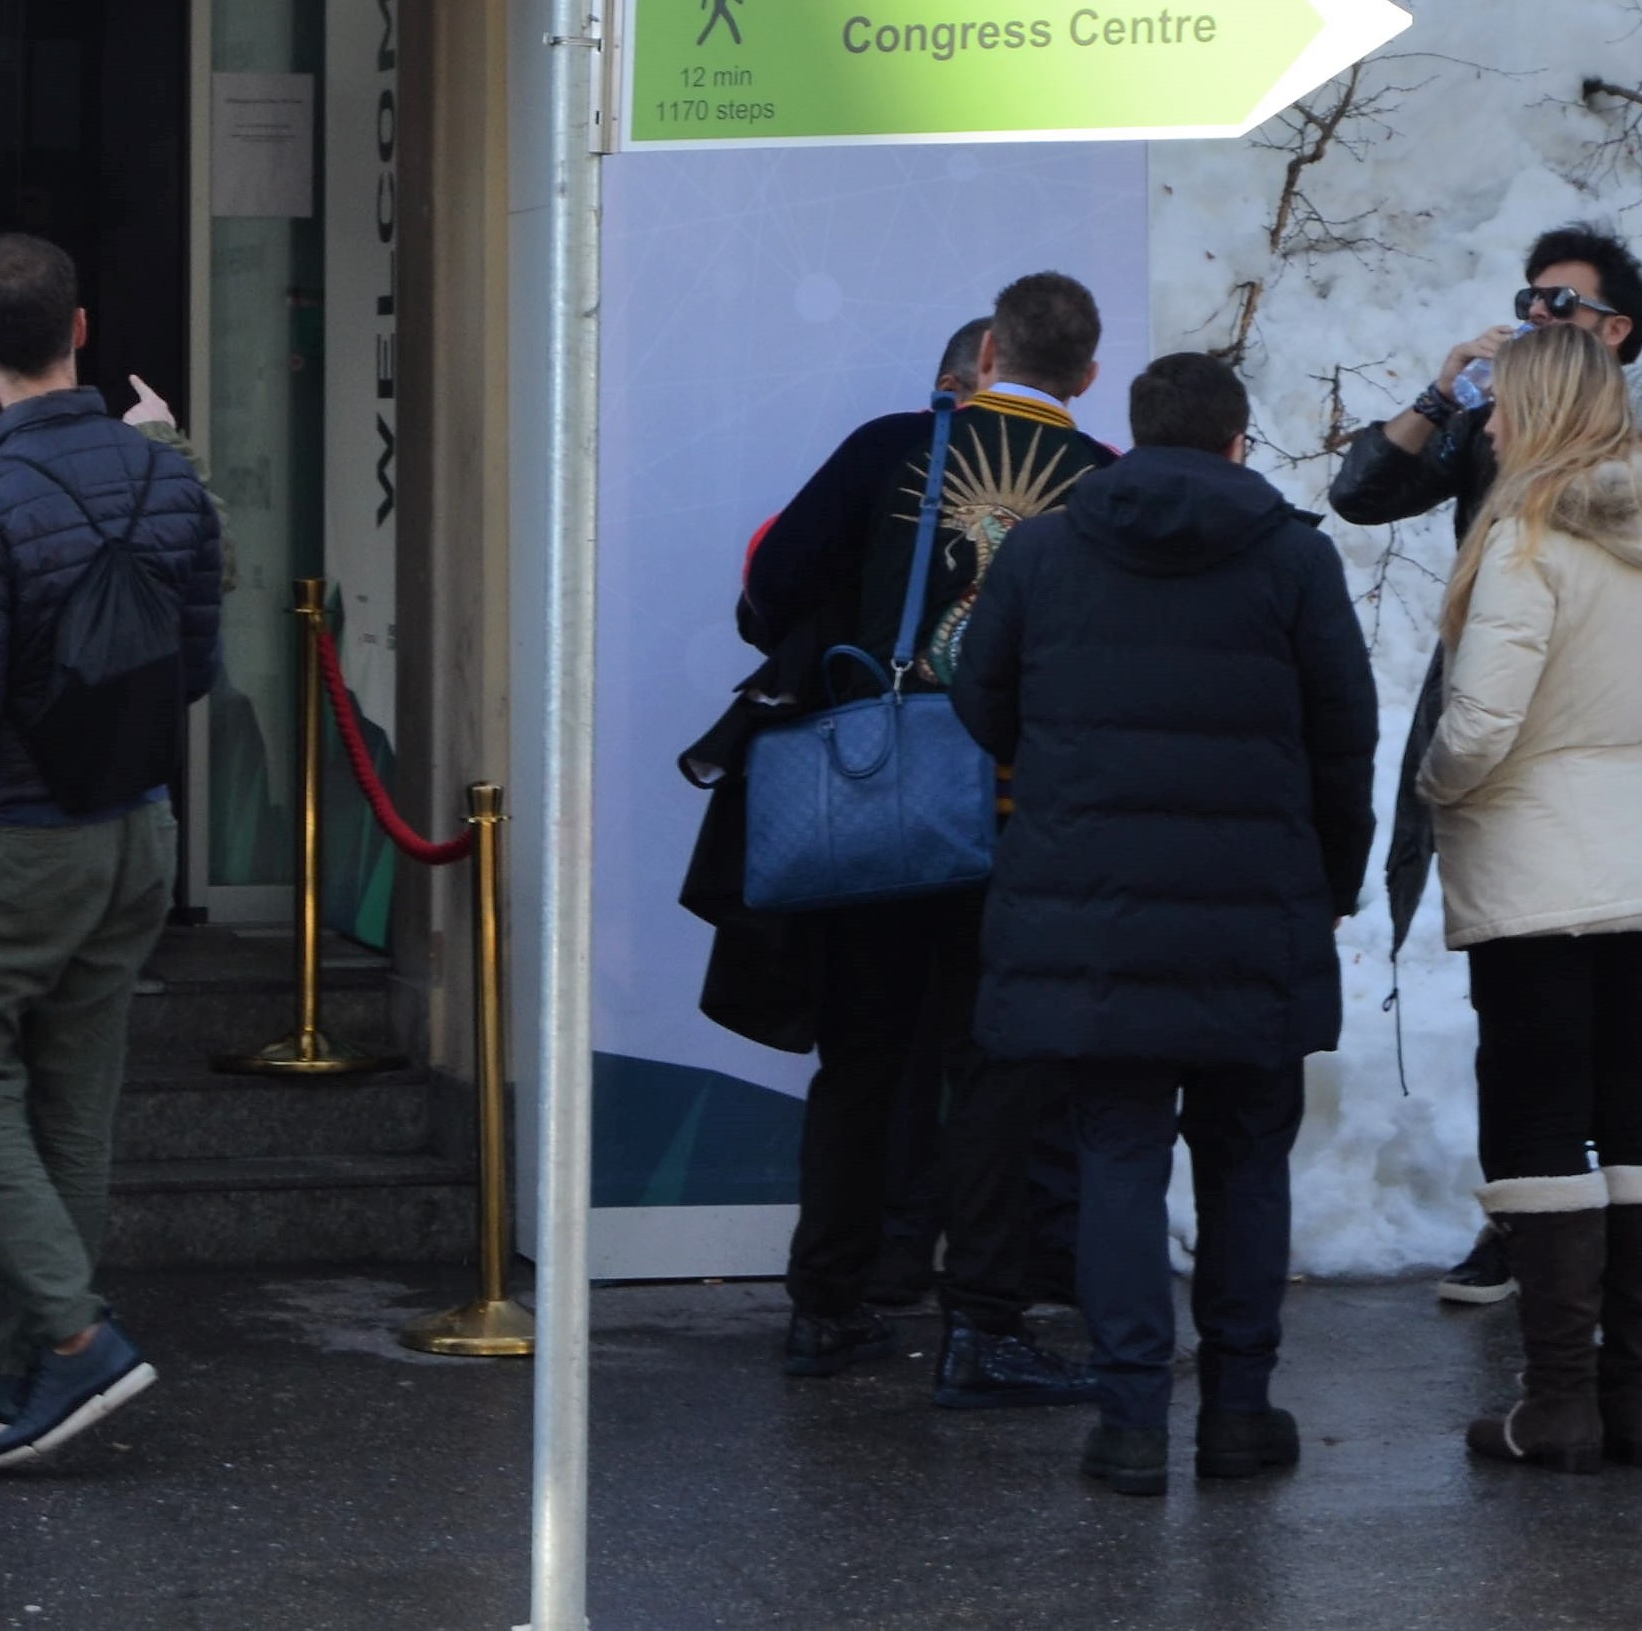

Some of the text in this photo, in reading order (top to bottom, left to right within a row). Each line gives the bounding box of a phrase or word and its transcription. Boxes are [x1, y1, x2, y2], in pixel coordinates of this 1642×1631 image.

[842, 8, 1217, 61] Congress Centre
[680, 65, 753, 88] 12 min
[656, 99, 775, 125] 1170 steps
